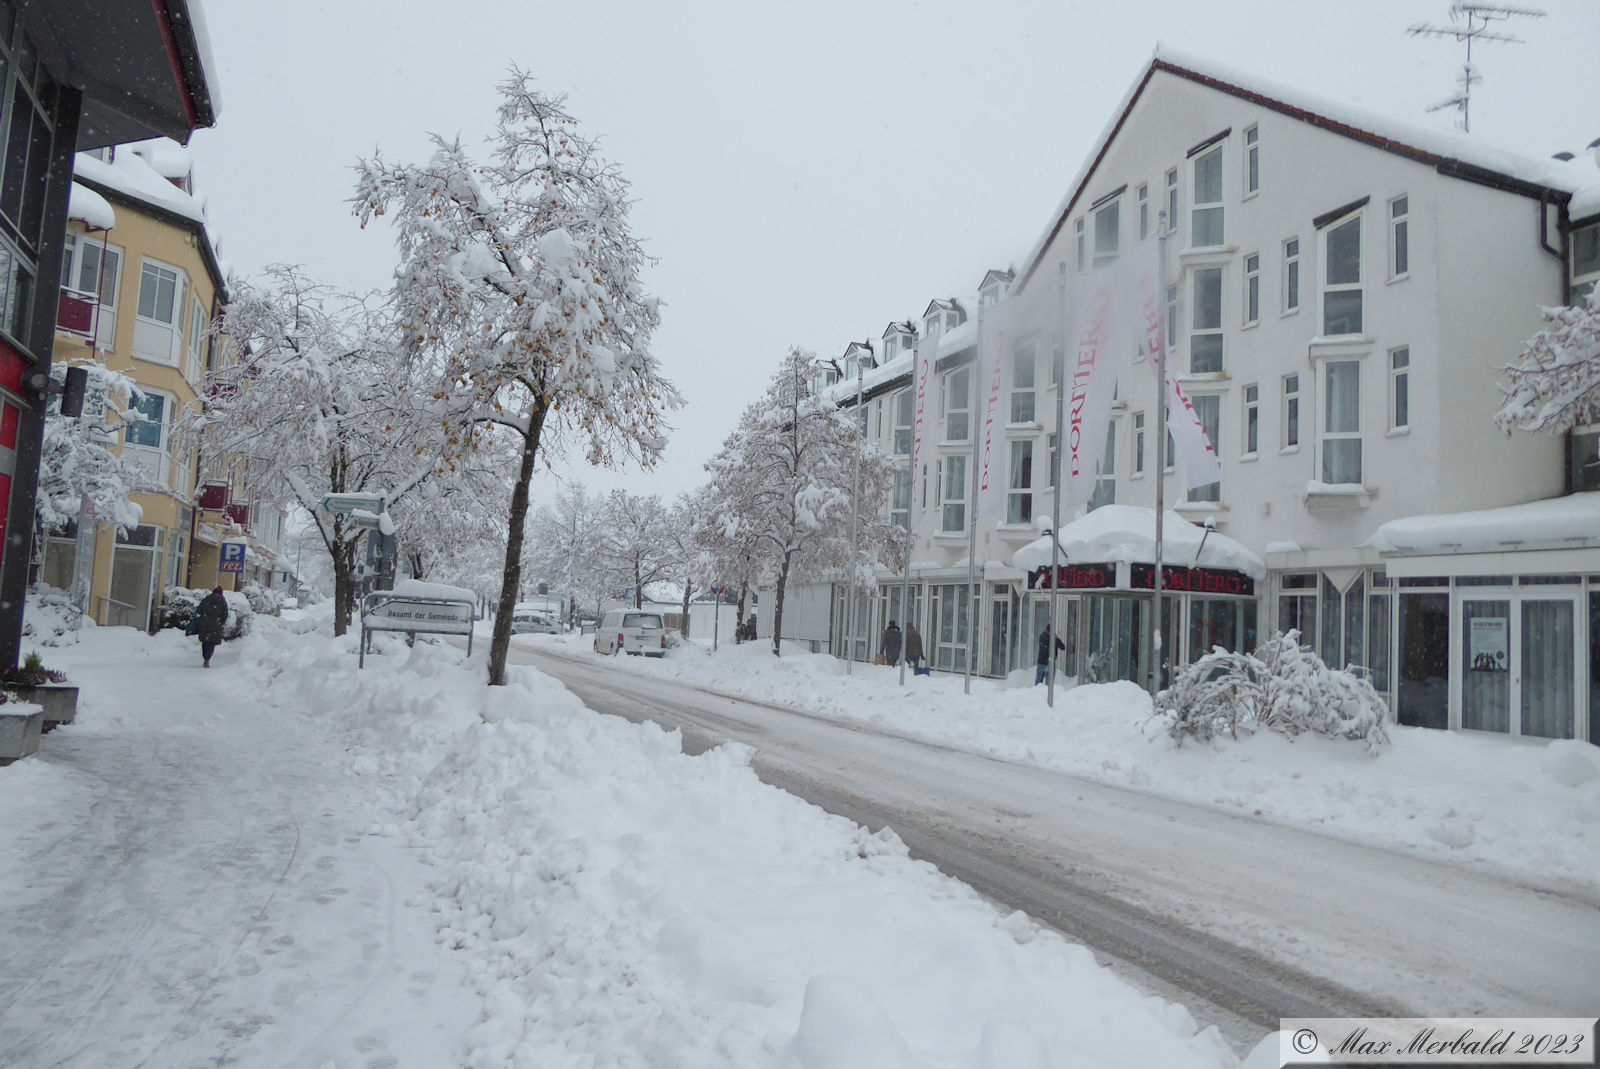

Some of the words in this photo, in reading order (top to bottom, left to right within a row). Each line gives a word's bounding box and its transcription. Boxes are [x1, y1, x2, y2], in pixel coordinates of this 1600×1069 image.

[225, 544, 241, 560] P
[388, 610, 412, 618] Bauamt
[429, 613, 458, 621] Gemeinde
